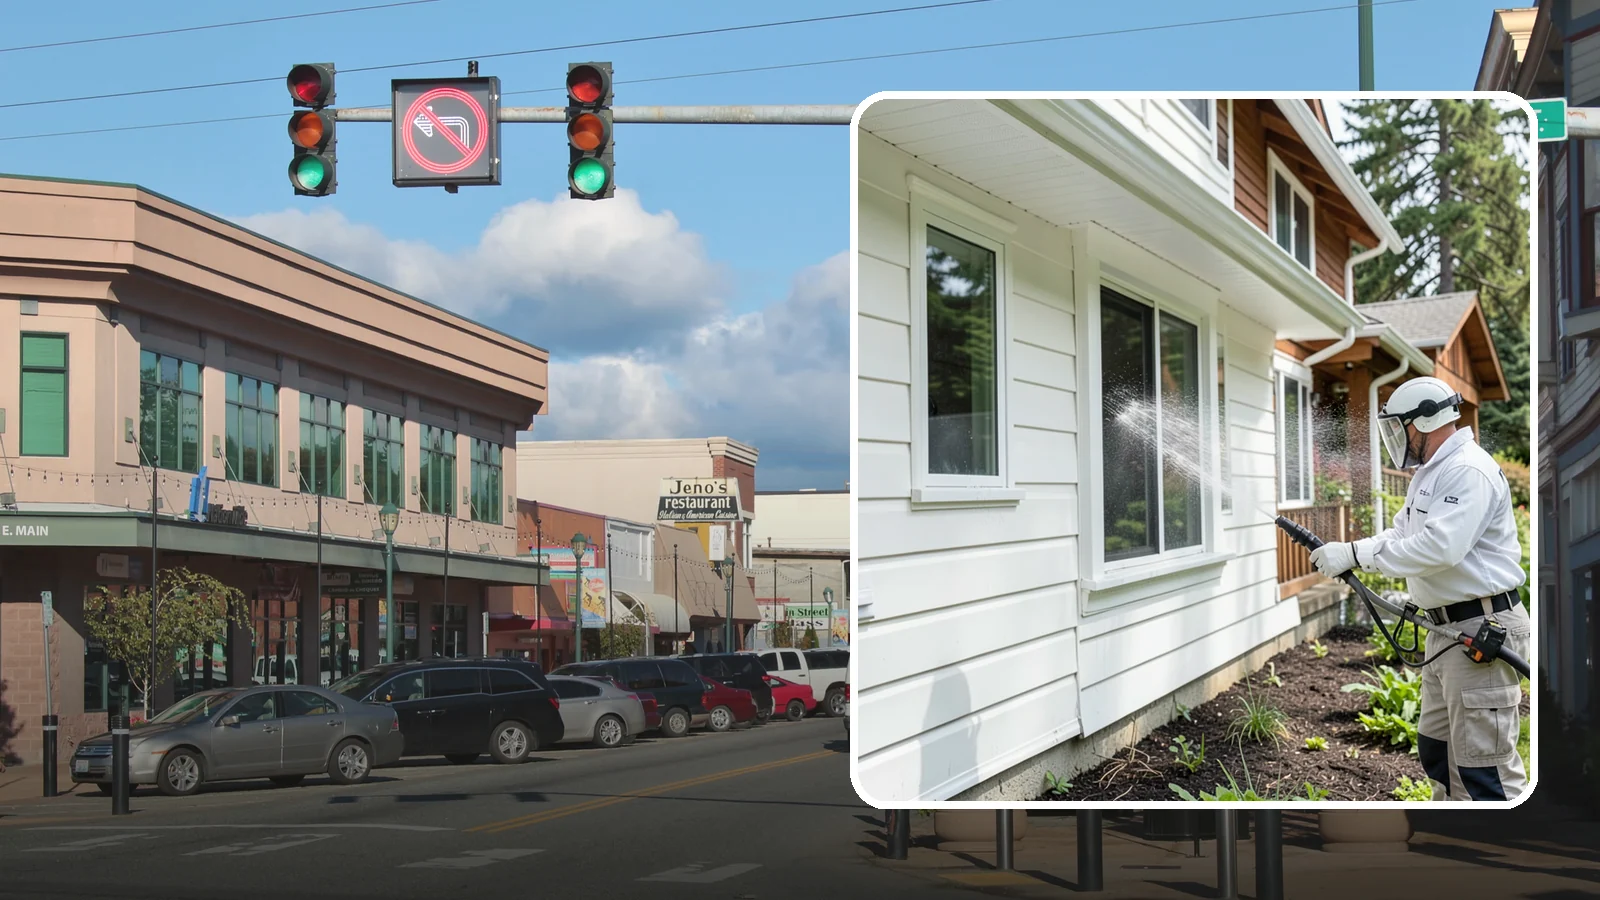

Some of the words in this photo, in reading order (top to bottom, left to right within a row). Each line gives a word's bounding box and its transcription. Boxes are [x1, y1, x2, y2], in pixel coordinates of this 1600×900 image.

[670, 480, 727, 494] Jeno's
[665, 496, 731, 509] restaurant
[686, 510, 714, 519] American
[715, 509, 738, 519] Cuisine
[2, 525, 13, 536] E.
[15, 525, 49, 536] MAIN
[797, 607, 828, 617] Street
